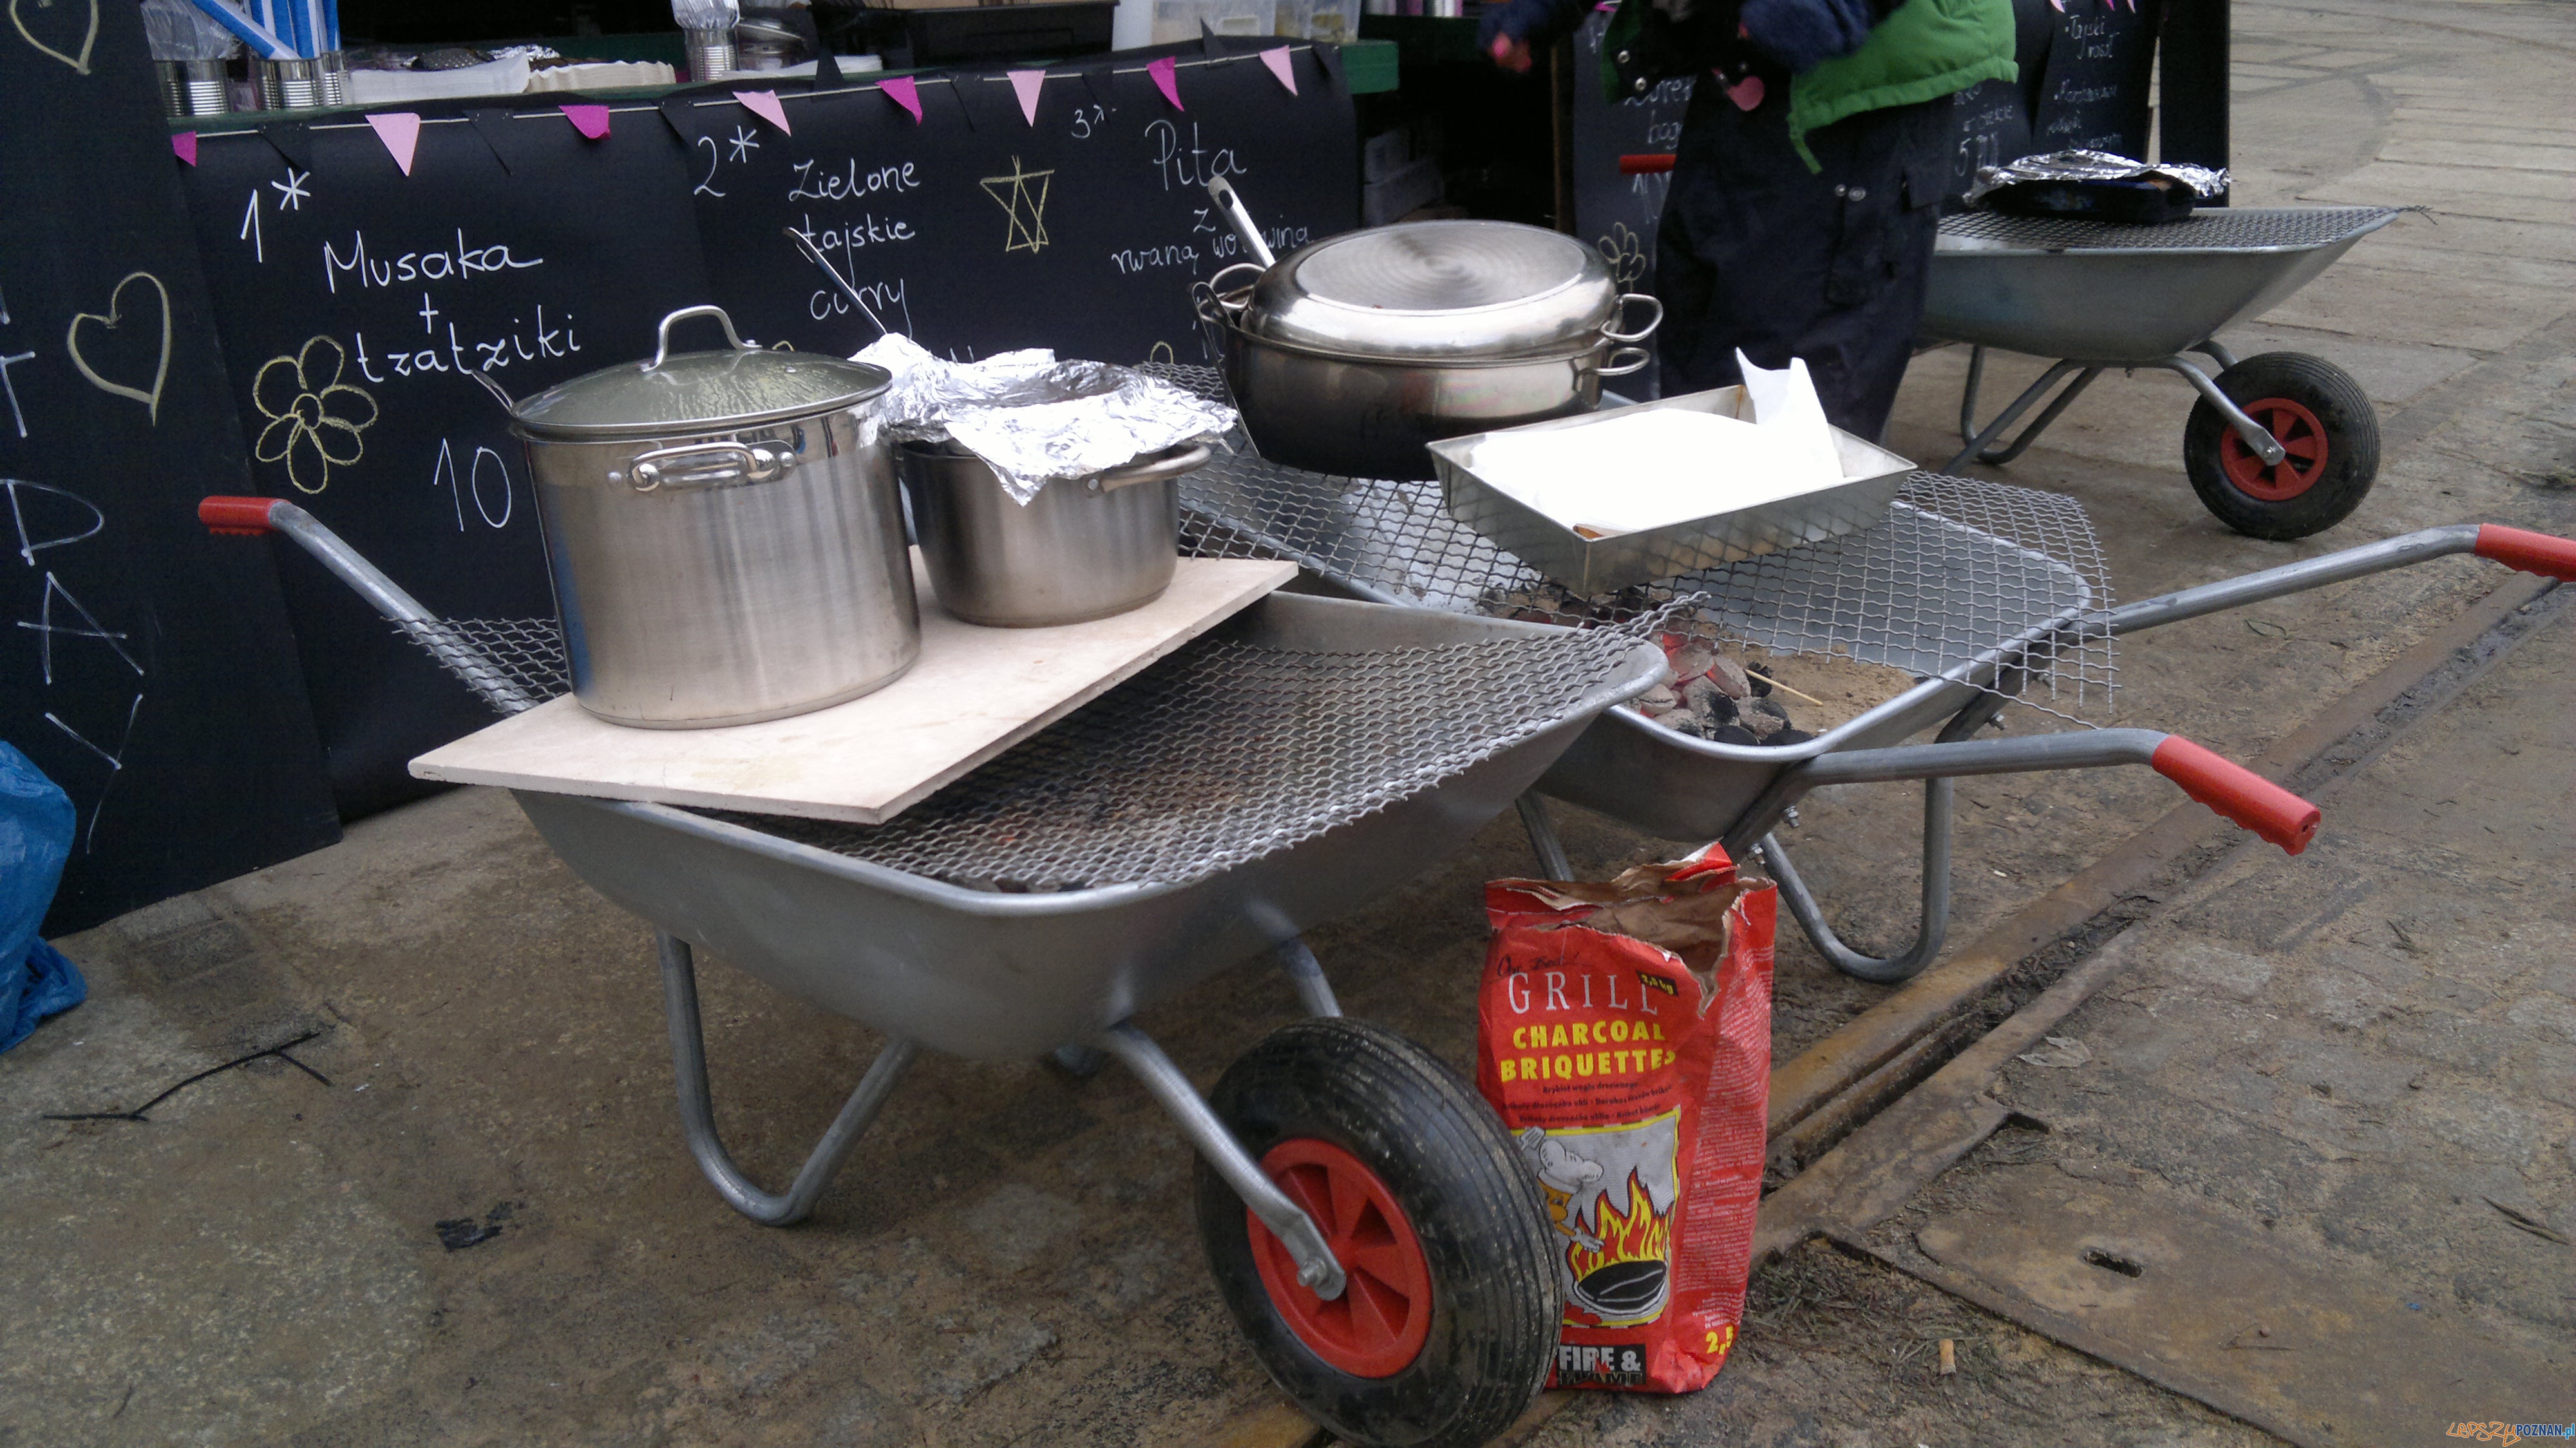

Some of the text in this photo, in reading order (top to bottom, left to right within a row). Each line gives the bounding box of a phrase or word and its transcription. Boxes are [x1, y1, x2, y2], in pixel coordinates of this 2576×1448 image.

[788, 158, 921, 202] Zielone
[1144, 120, 1247, 191] Pita
[324, 227, 544, 294] Musaka
[802, 213, 916, 293] tajskie
[810, 278, 913, 341] curry
[355, 304, 581, 383] tzatziki
[433, 437, 512, 532] 10
[1508, 970, 1658, 1016] GRILL
[1513, 1020, 1666, 1050] CHARCOAL
[1558, 1345, 1642, 1372] FIRE &
